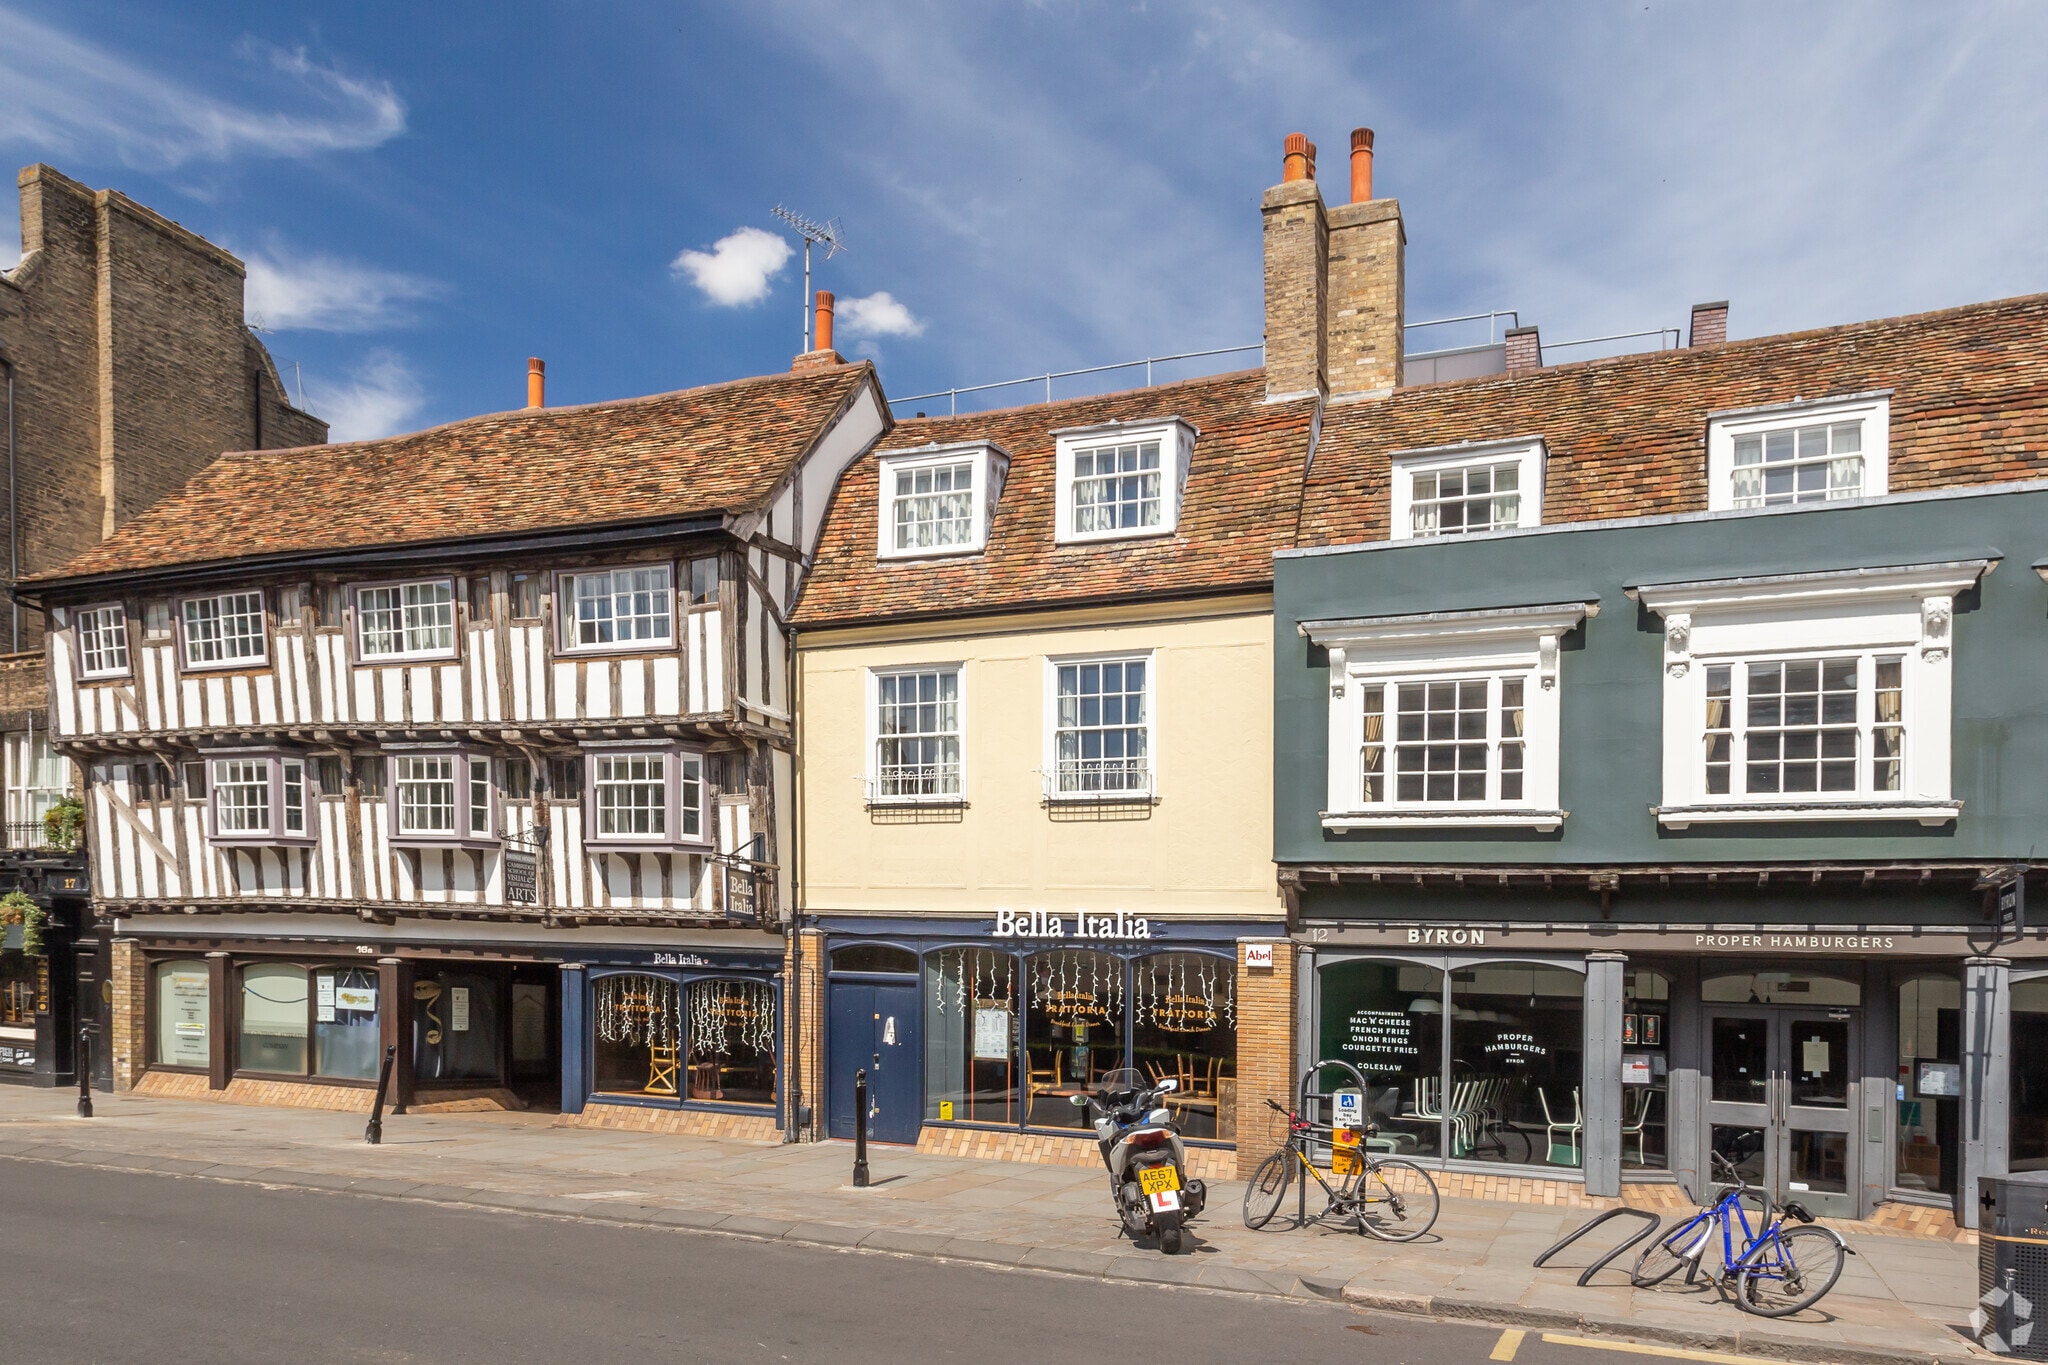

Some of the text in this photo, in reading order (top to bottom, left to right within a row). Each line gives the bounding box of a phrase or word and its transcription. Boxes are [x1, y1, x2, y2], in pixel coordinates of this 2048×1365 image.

[507, 861, 535, 870] CAMBRIDGE
[507, 867, 527, 876] SCHOOL
[64, 878, 76, 888] 17
[507, 874, 527, 882] VISUAL
[730, 876, 753, 896] Bella
[507, 887, 536, 902] ARTS
[730, 896, 754, 915] Italia
[992, 907, 1151, 939] Bella Italia
[1312, 928, 1328, 943] 12
[1408, 928, 1484, 945] BYRON
[1695, 935, 1894, 948] PROPER HAMBURGERS
[653, 953, 702, 965] Bella Italia
[1247, 950, 1271, 961] Abel
[1185, 995, 1205, 1005] Italia
[1045, 1004, 1106, 1015] TRATTORIA
[1153, 1008, 1217, 1019] TRATTORIA
[1378, 1018, 1411, 1027] CHEESE
[1350, 1026, 1384, 1034] FRENCH
[1352, 1035, 1408, 1045] ONION RINGS
[1485, 1033, 1546, 1055] PROPER HAMBURGERS
[1342, 1043, 1419, 1054] COURGETTE FRIES
[1357, 1062, 1402, 1072] COLESLAW
[1143, 1169, 1172, 1182] AE67
[1149, 1180, 1172, 1192] XPX
[1156, 1192, 1172, 1207] L
